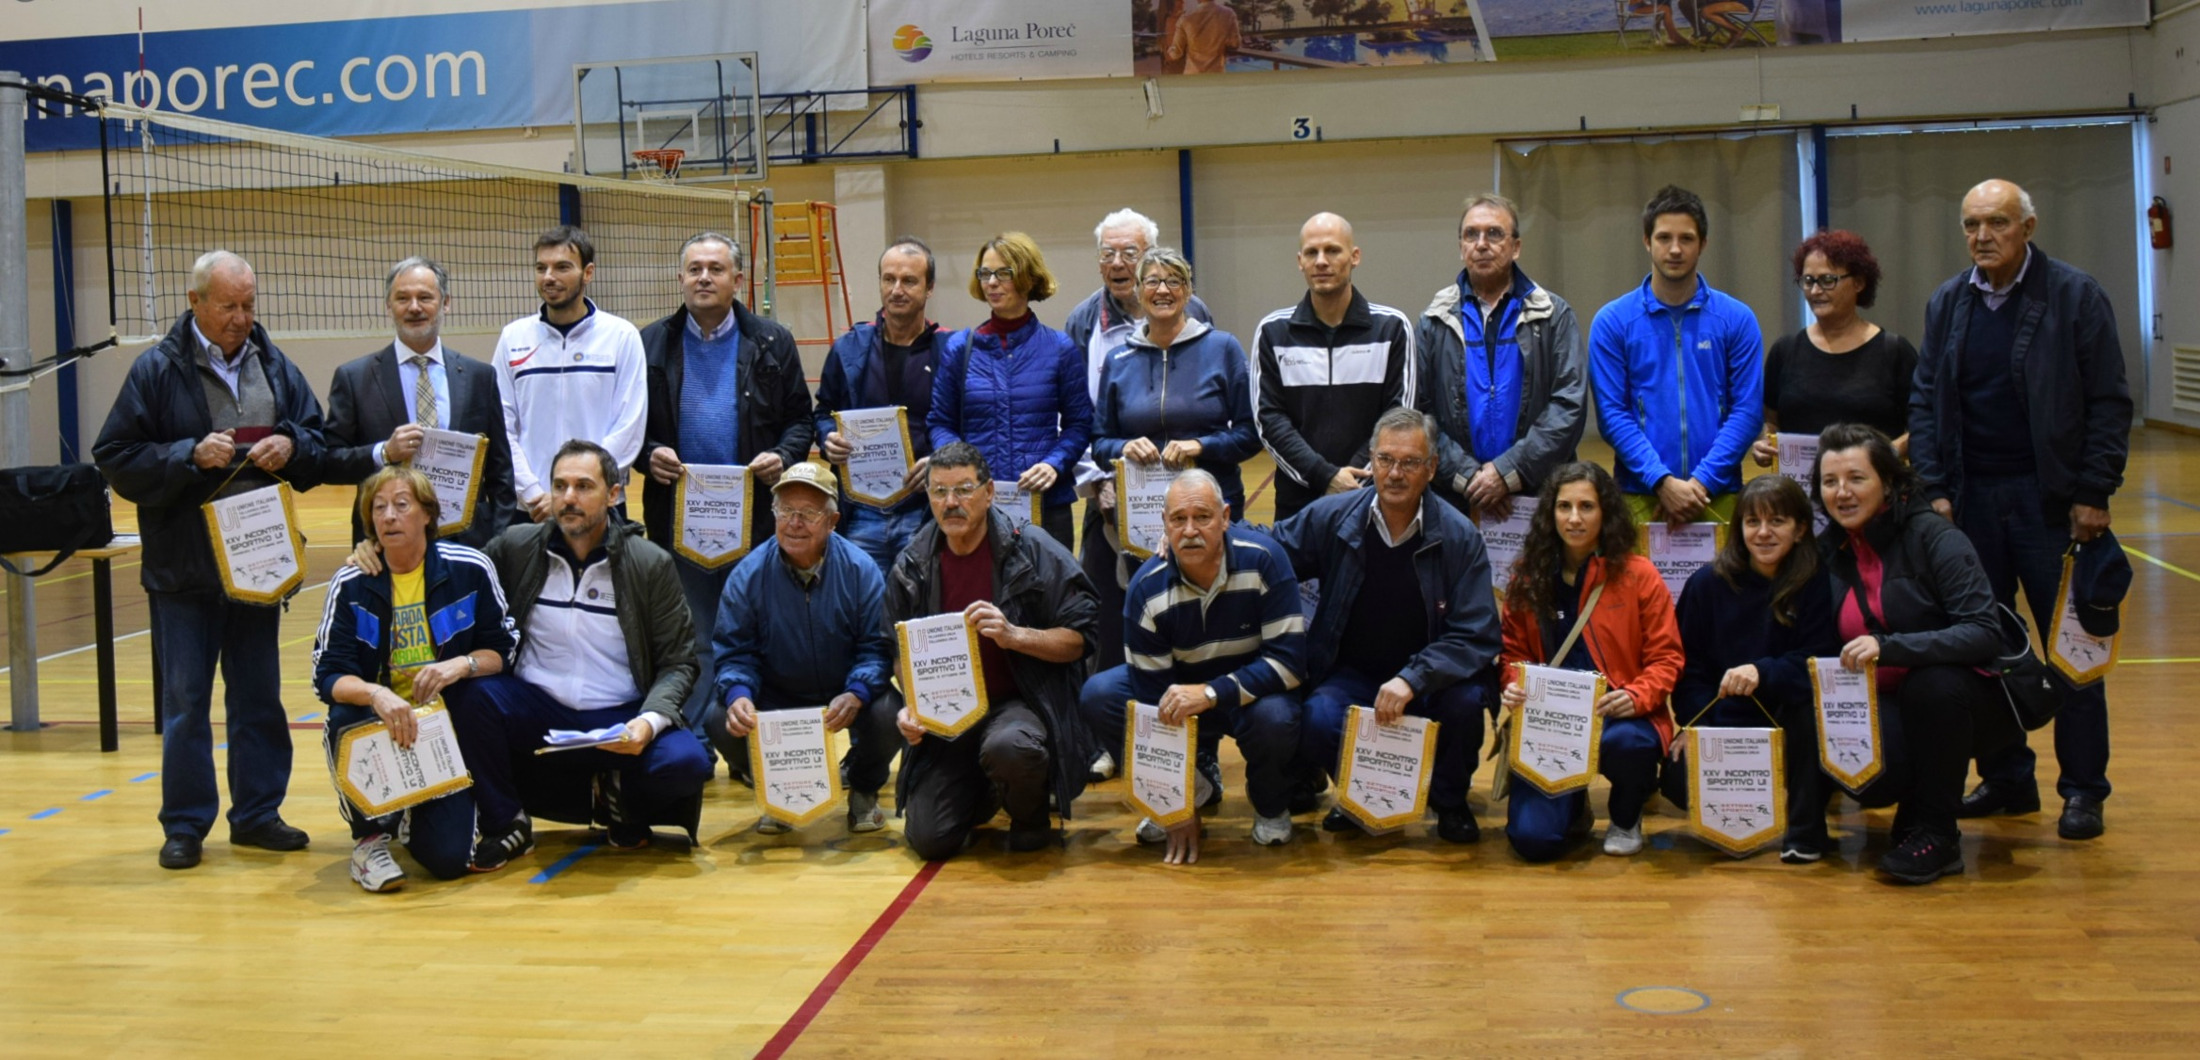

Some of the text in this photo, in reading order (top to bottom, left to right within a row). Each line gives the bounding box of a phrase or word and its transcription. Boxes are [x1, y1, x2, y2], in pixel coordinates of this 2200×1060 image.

[952, 22, 1077, 46] Laguna Poreč
[951, 52, 984, 61] HOTELS
[987, 51, 1026, 60] RESORTS
[1038, 49, 1077, 58] CAMPING
[24, 50, 486, 132] naporec.com
[1293, 117, 1311, 139] 3
[863, 442, 899, 451] INCONTRO
[850, 450, 887, 459] SPORTIVO
[414, 463, 470, 479] XXV INCONTRO
[424, 473, 465, 486] ORTIVO UI
[1131, 502, 1165, 510] SPORTIV
[226, 523, 285, 545] XXV INCONTRO
[230, 535, 272, 552] SPORTIVO
[927, 624, 964, 634] UNIONE ITALIANA
[913, 653, 968, 668] XXV INCONTRO
[917, 664, 956, 676] SPORTIVO
[958, 662, 966, 670] UI
[1547, 679, 1591, 690] UNIONE ITALIANA
[1837, 702, 1868, 710] INCONTRO
[800, 718, 821, 726] ITALIANA
[1525, 707, 1588, 723] XXV INCONTRO
[1826, 711, 1857, 719] SPORTIVO
[1527, 716, 1571, 730] SPORTIVO
[784, 747, 824, 757] INCONTRO
[1135, 743, 1185, 761] XXV INCONTRO
[1137, 752, 1171, 766] SPORTIVO
[1356, 747, 1418, 765] XXV INCONTRO
[409, 747, 427, 788] CONTRO
[769, 757, 811, 766] SPORTIVO
[1358, 755, 1401, 770] SPORTIVO
[1404, 764, 1413, 772] UI
[1706, 778, 1754, 786] SPORTIVO
